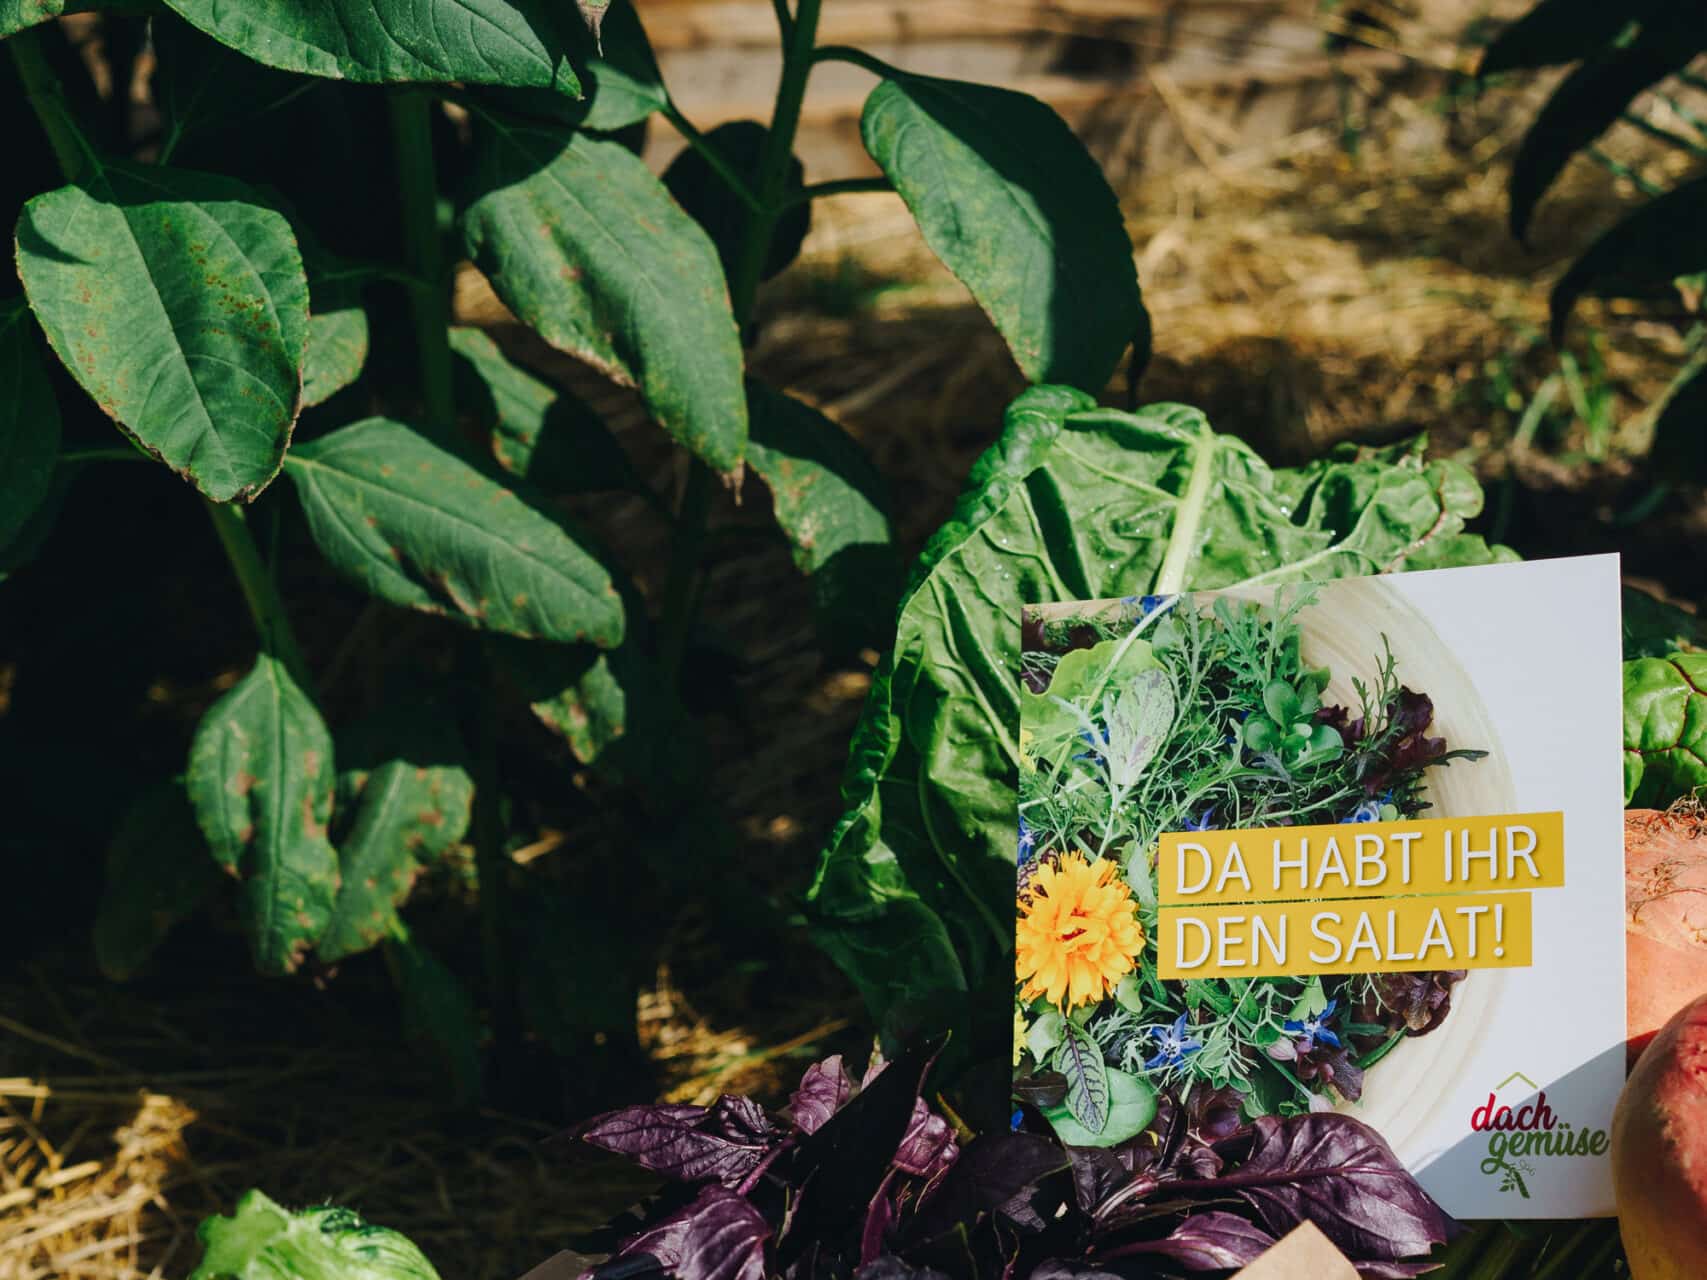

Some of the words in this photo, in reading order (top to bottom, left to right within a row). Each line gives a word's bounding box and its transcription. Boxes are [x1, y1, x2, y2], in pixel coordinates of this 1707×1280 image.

[1176, 841, 1251, 894] DA
[1272, 832, 1422, 890] HABT
[1444, 825, 1541, 882] IHR
[1175, 914, 1288, 968] DEN
[1309, 903, 1505, 964] SALAT!
[1471, 1091, 1558, 1131] dach
[1480, 1122, 1611, 1175] gemüse
